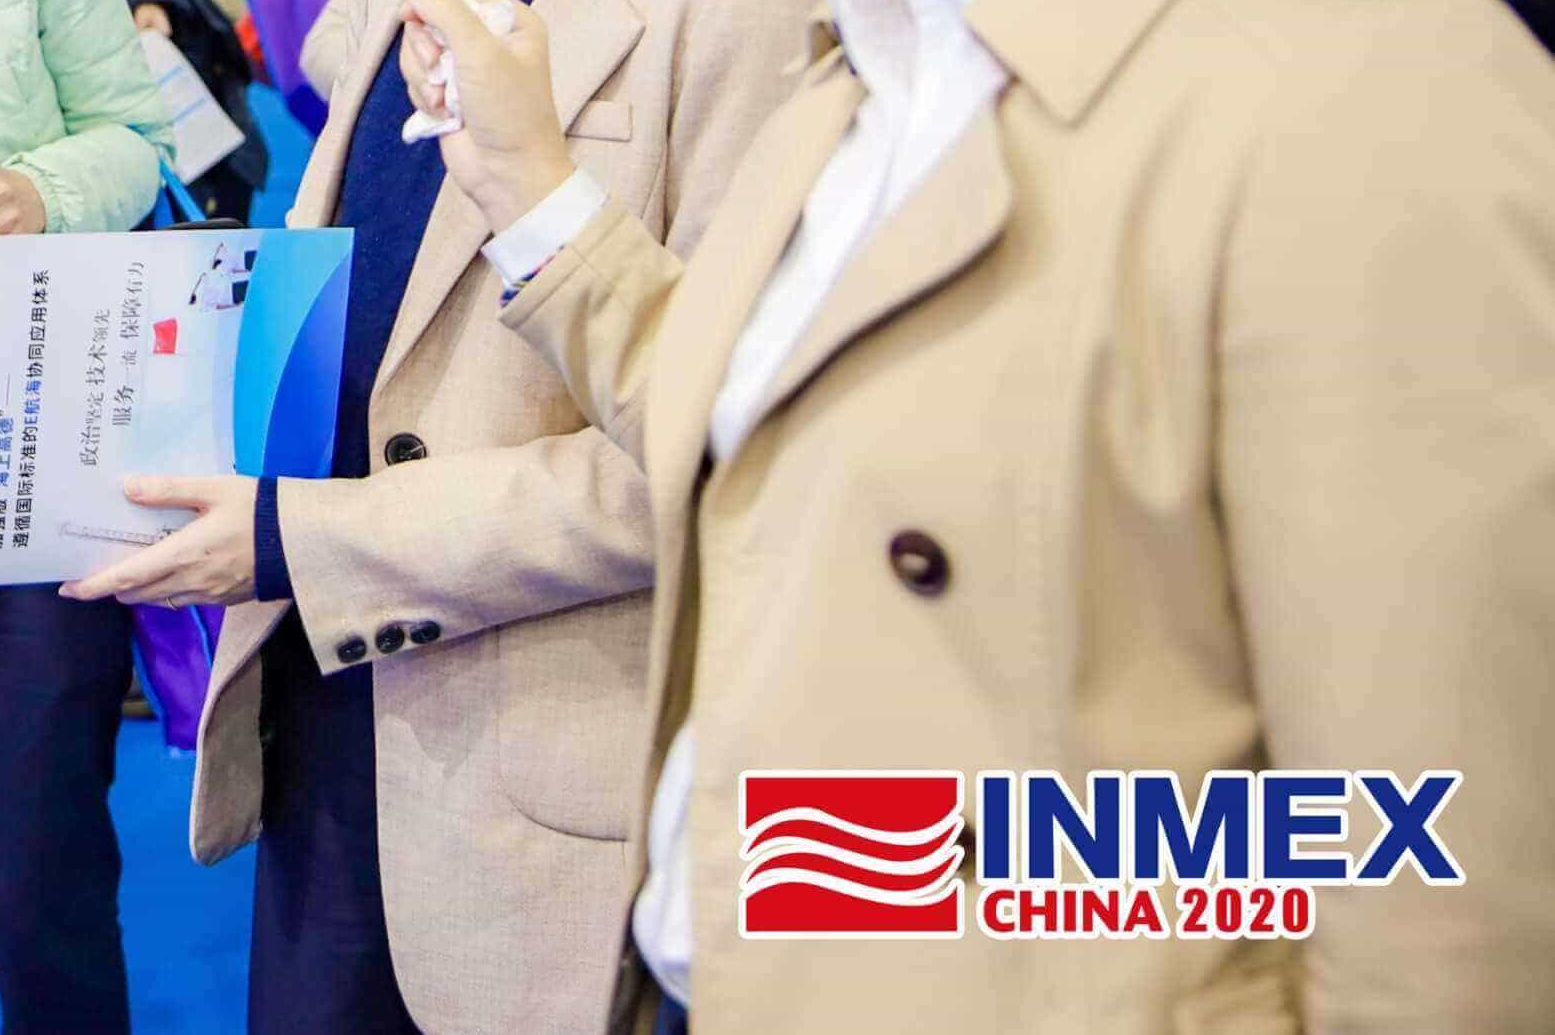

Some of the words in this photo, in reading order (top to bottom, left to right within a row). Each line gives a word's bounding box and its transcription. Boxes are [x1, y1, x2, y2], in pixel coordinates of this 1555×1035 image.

[11, 269, 50, 549] 遵循国际标准的E航海协同应用体系
